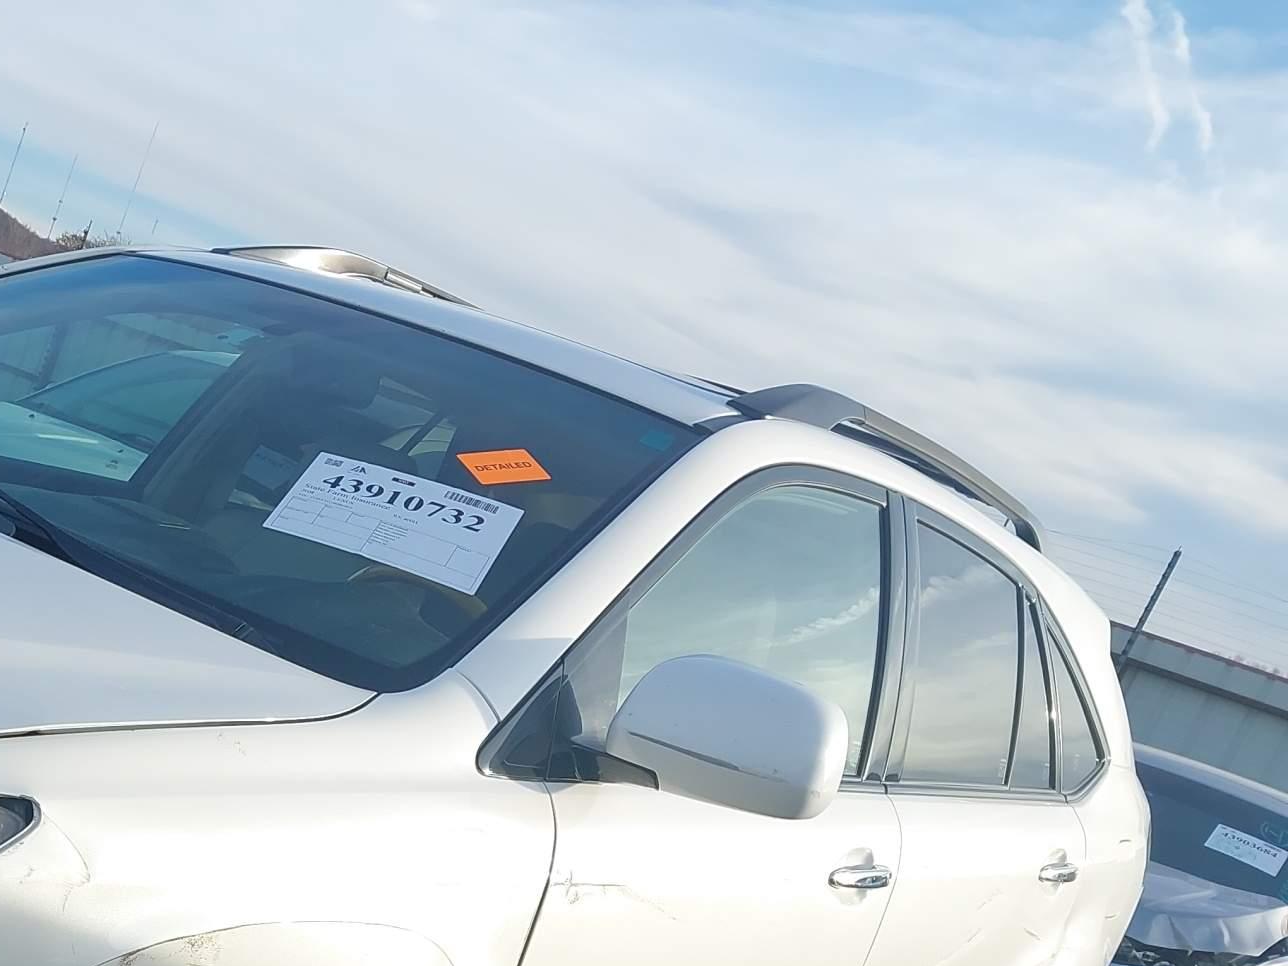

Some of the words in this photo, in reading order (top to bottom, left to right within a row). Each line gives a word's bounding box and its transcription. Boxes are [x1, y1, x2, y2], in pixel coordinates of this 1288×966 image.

[474, 461, 532, 472] DETAILED
[322, 475, 485, 532] 43910732
[327, 488, 349, 501] Farm
[351, 495, 392, 511] Insurance
